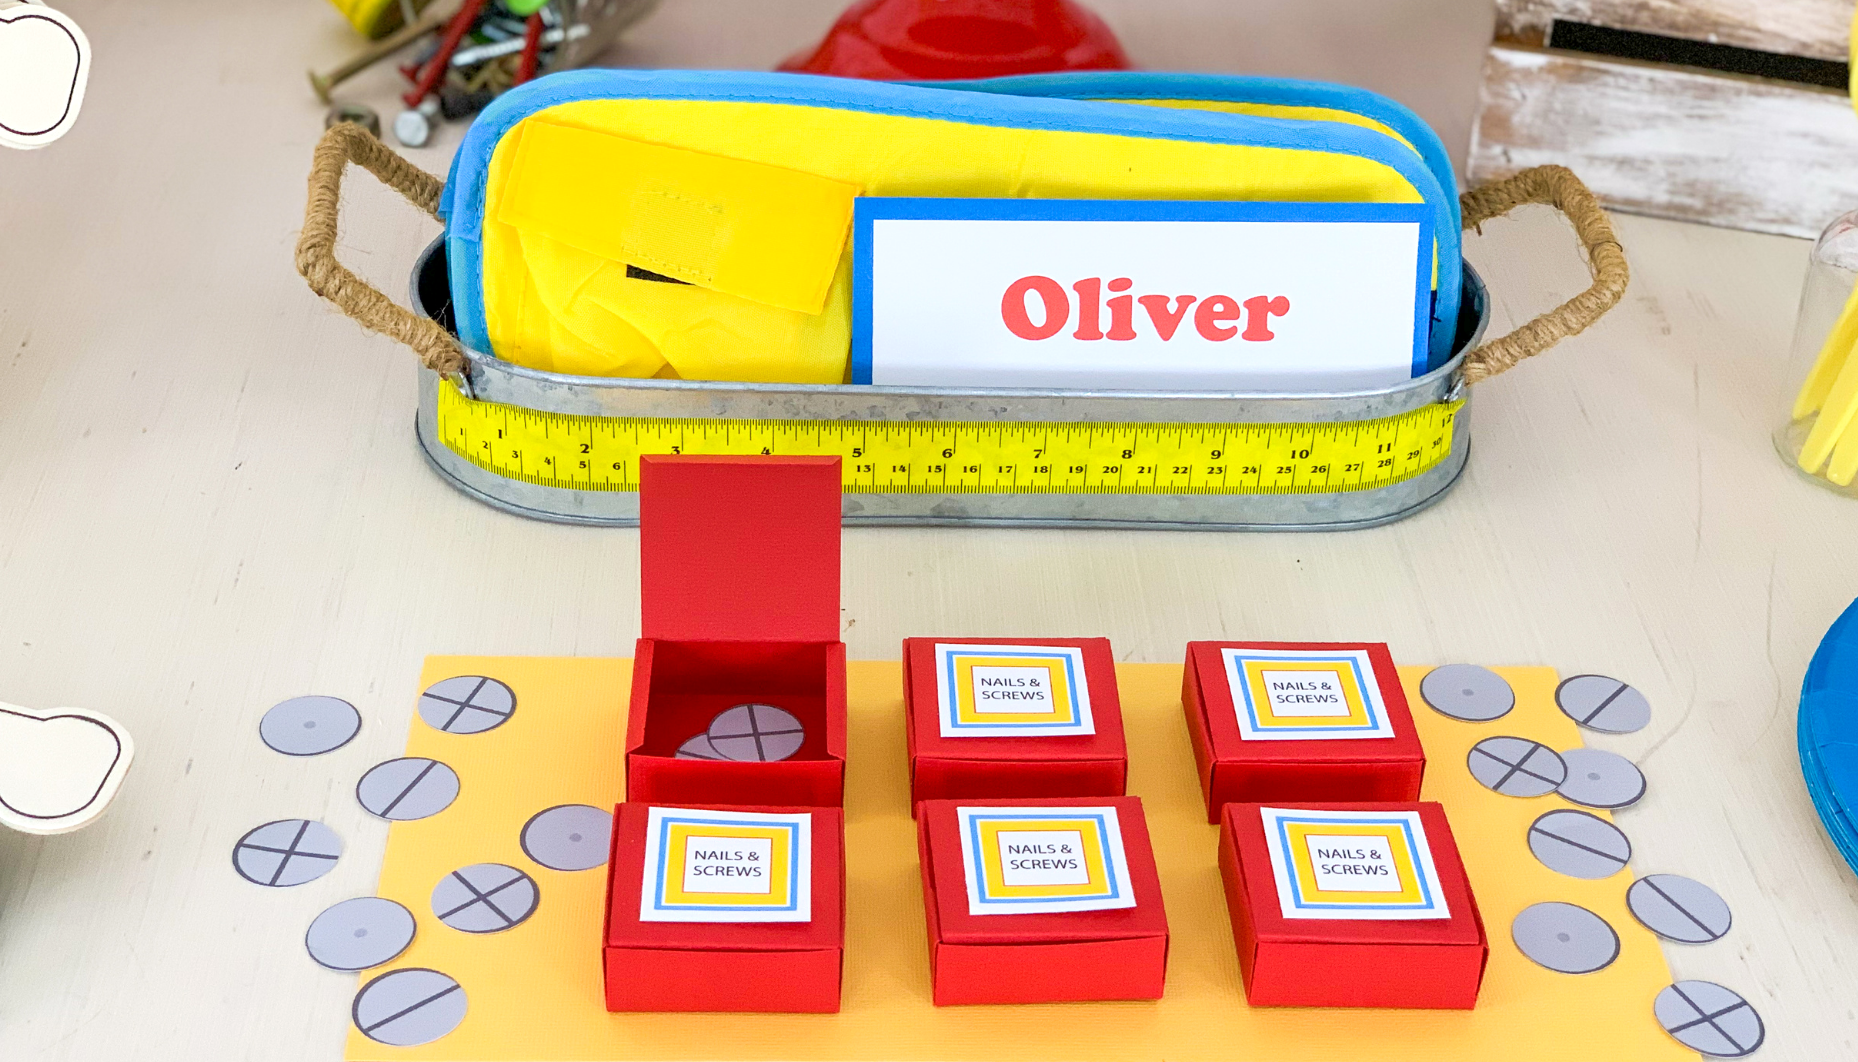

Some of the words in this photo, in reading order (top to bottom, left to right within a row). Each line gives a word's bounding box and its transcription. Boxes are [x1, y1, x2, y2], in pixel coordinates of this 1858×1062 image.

[1001, 275, 1291, 342] Oliver
[498, 429, 503, 439] 1
[580, 443, 590, 454] 2
[671, 446, 681, 454] 3
[761, 446, 771, 455] 4
[852, 448, 862, 458] 5
[942, 448, 953, 459] 6
[1033, 449, 1043, 459] 7
[1121, 449, 1133, 459] 8
[1210, 450, 1222, 460] 9
[1290, 449, 1310, 460] 10
[1377, 442, 1391, 454] 11
[460, 427, 464, 436] 1
[482, 440, 489, 449] 2
[511, 450, 519, 459] 3
[544, 456, 552, 466] 4
[579, 461, 587, 469] 5
[612, 462, 621, 471] 6
[856, 464, 872, 473] 13
[892, 464, 907, 473] 14
[927, 465, 943, 473] 15
[963, 465, 978, 474] 16
[998, 465, 1013, 474] 17
[1033, 465, 1049, 474] 18
[1069, 465, 1084, 474] 19
[1102, 466, 1119, 474] 20
[1137, 466, 1152, 474] 21
[1172, 466, 1188, 475] 22
[1207, 466, 1223, 475] 23
[1242, 466, 1258, 475] 24
[1276, 466, 1292, 475] 25
[1310, 465, 1327, 474] 26
[1344, 463, 1361, 472] 27
[1377, 458, 1392, 469] 28
[1406, 449, 1420, 461] 29
[1431, 436, 1442, 450] 30
[980, 677, 1026, 687] NAILS
[1029, 678, 1040, 687] &
[1272, 682, 1317, 691] NAILS
[1321, 681, 1332, 691] &
[981, 690, 1044, 700] SCREWS
[1276, 694, 1339, 704] SCREWS
[1008, 844, 1056, 854] NAILS
[1060, 844, 1072, 854] &
[1317, 848, 1366, 860] NAILS
[1370, 849, 1382, 860] &
[694, 850, 743, 861] NAILS
[747, 851, 760, 861] &
[1010, 859, 1078, 870] SCREWS
[1321, 864, 1389, 876] SCREWS
[693, 865, 762, 877] SCREWS
